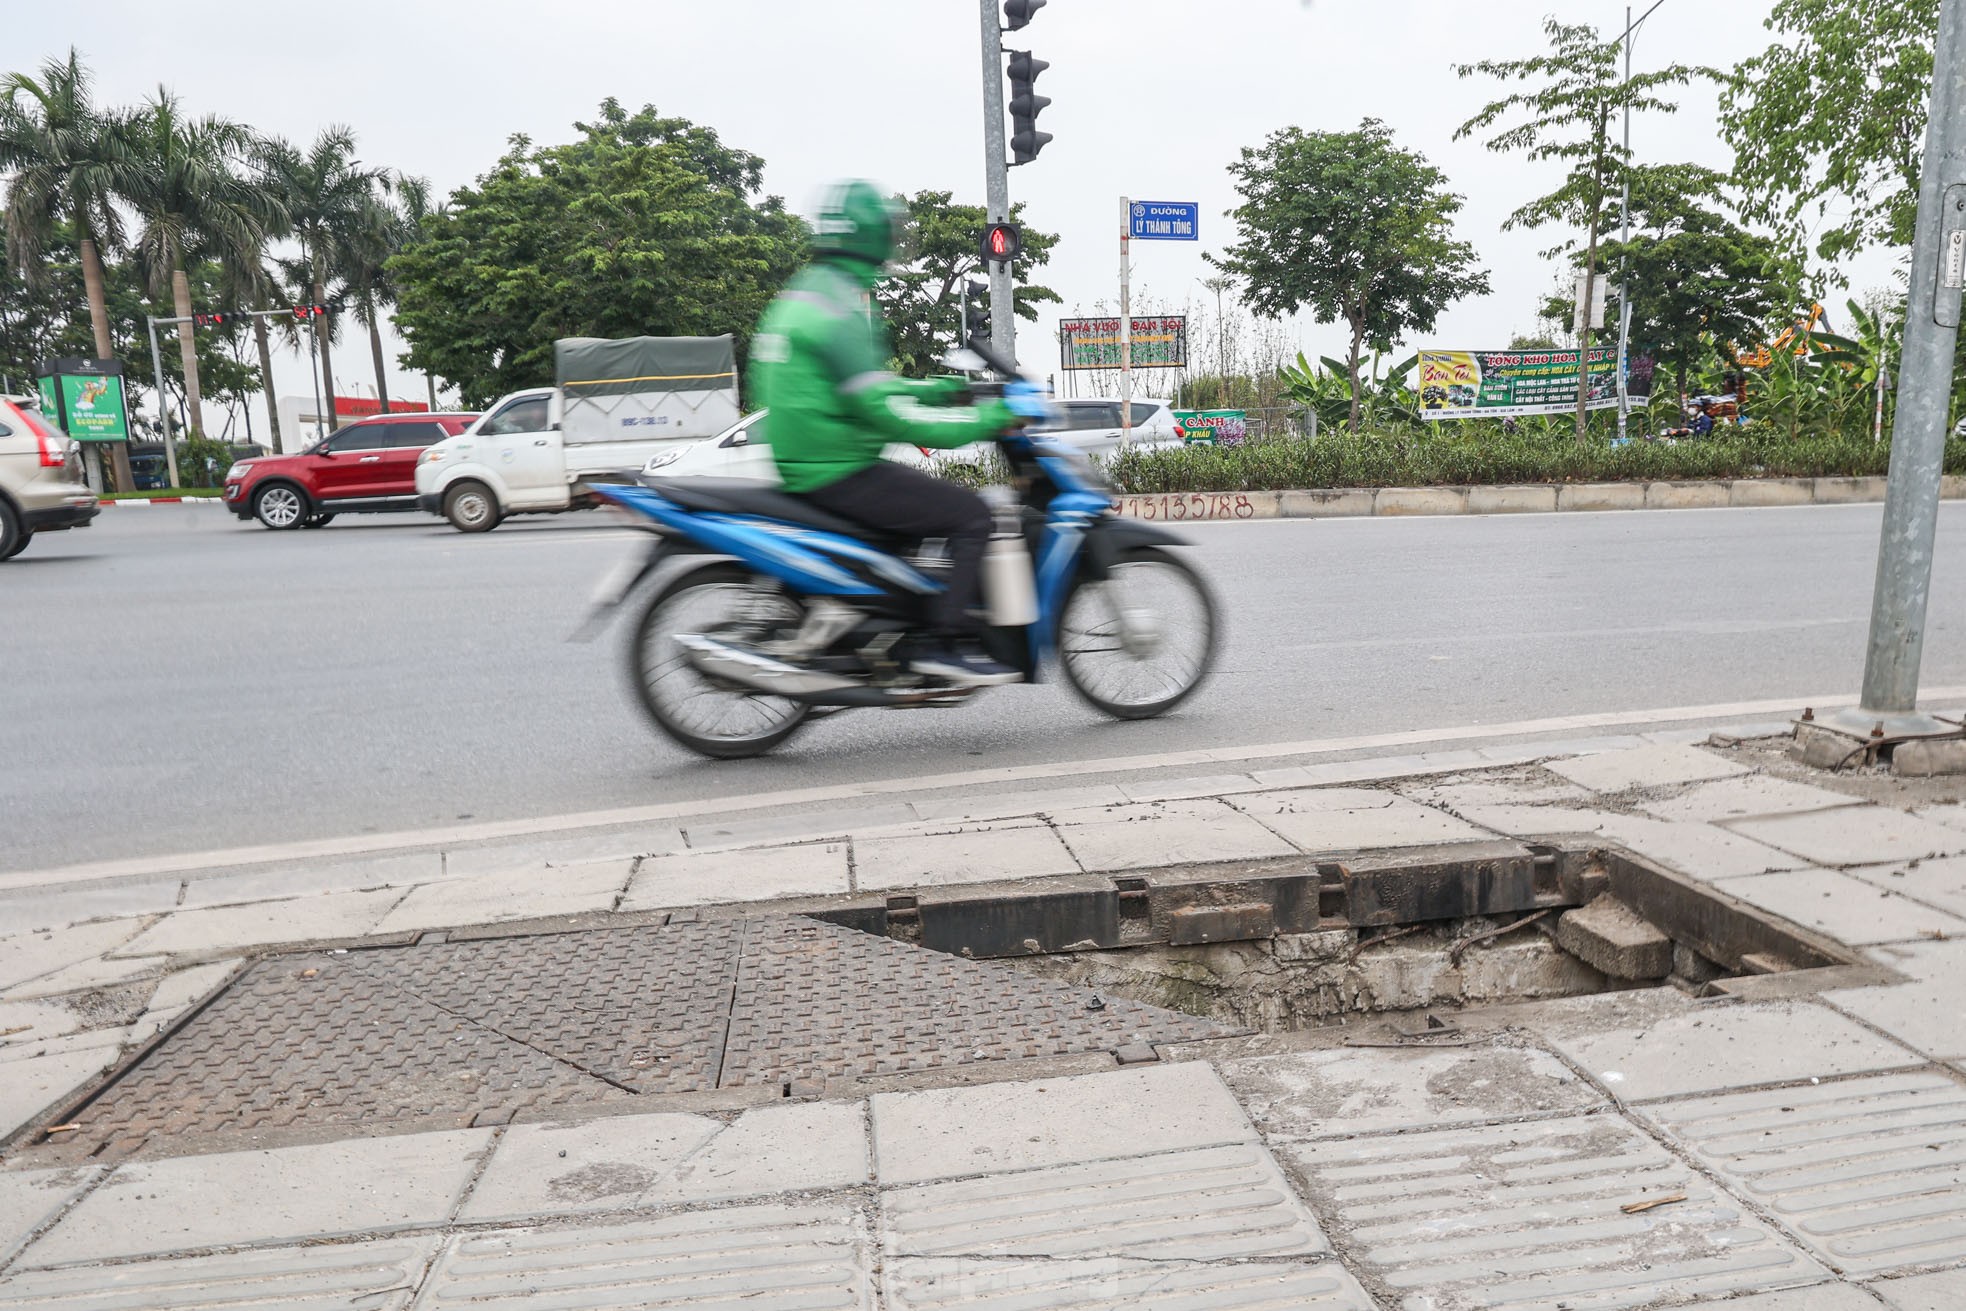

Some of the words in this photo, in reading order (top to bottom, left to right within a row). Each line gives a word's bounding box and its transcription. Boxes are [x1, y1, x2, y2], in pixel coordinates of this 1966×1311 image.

[1150, 206, 1187, 216] ĐƯỜNG
[1136, 218, 1144, 233] LÝ
[1146, 218, 1171, 234] THÁNH
[1172, 218, 1192, 235] TÔNG
[1093, 319, 1120, 333] VƯỜ
[1487, 352, 1521, 366] TỔNG
[1523, 354, 1550, 365] KHO
[1552, 352, 1577, 364] HOA
[1186, 414, 1225, 427] CẢNH
